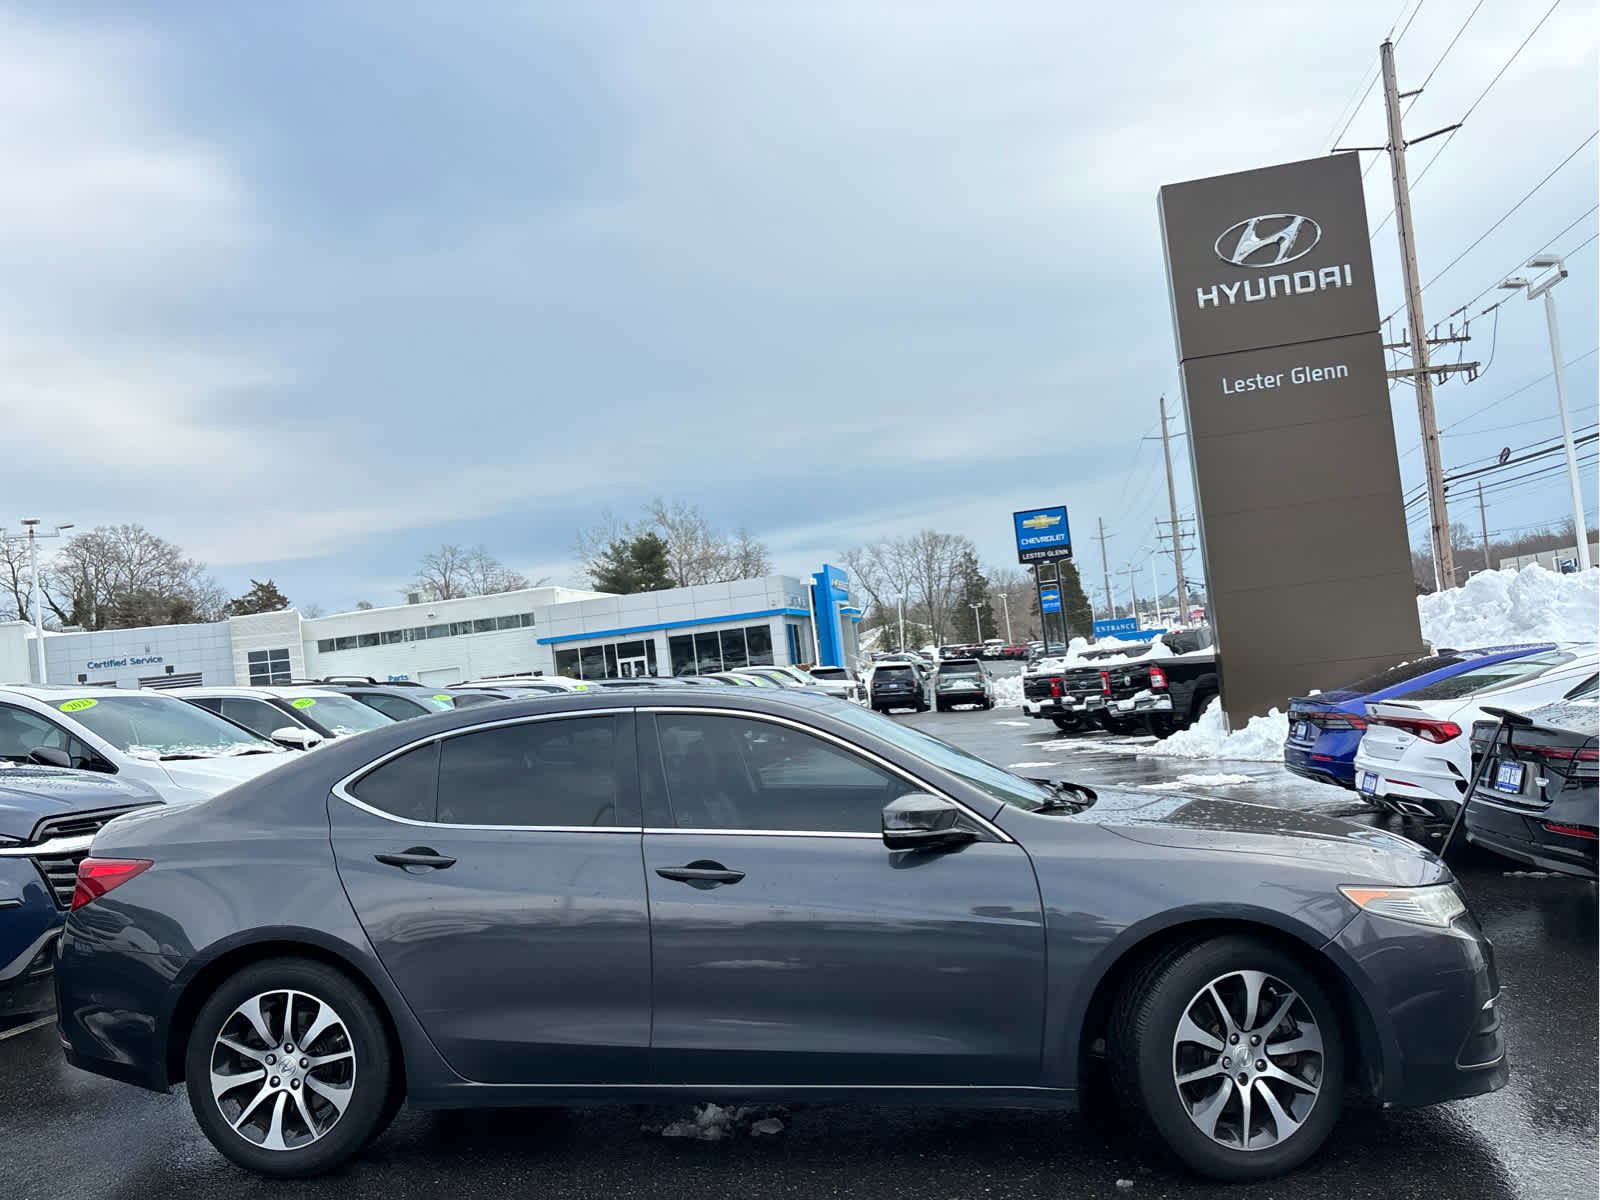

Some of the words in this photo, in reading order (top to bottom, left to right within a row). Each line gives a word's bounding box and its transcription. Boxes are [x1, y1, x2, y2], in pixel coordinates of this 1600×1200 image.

[1196, 263, 1353, 309] HYUNDAI
[1222, 373, 1284, 394] Lester
[1291, 364, 1349, 384] Glenn
[1021, 533, 1065, 545] CHEVROLET
[1022, 551, 1046, 560] LESTER
[1047, 548, 1069, 557] GLENN
[1095, 623, 1136, 633] ENTRANCE
[87, 658, 127, 669] Certified
[129, 656, 163, 665] Service
[387, 674, 408, 682] Parts
